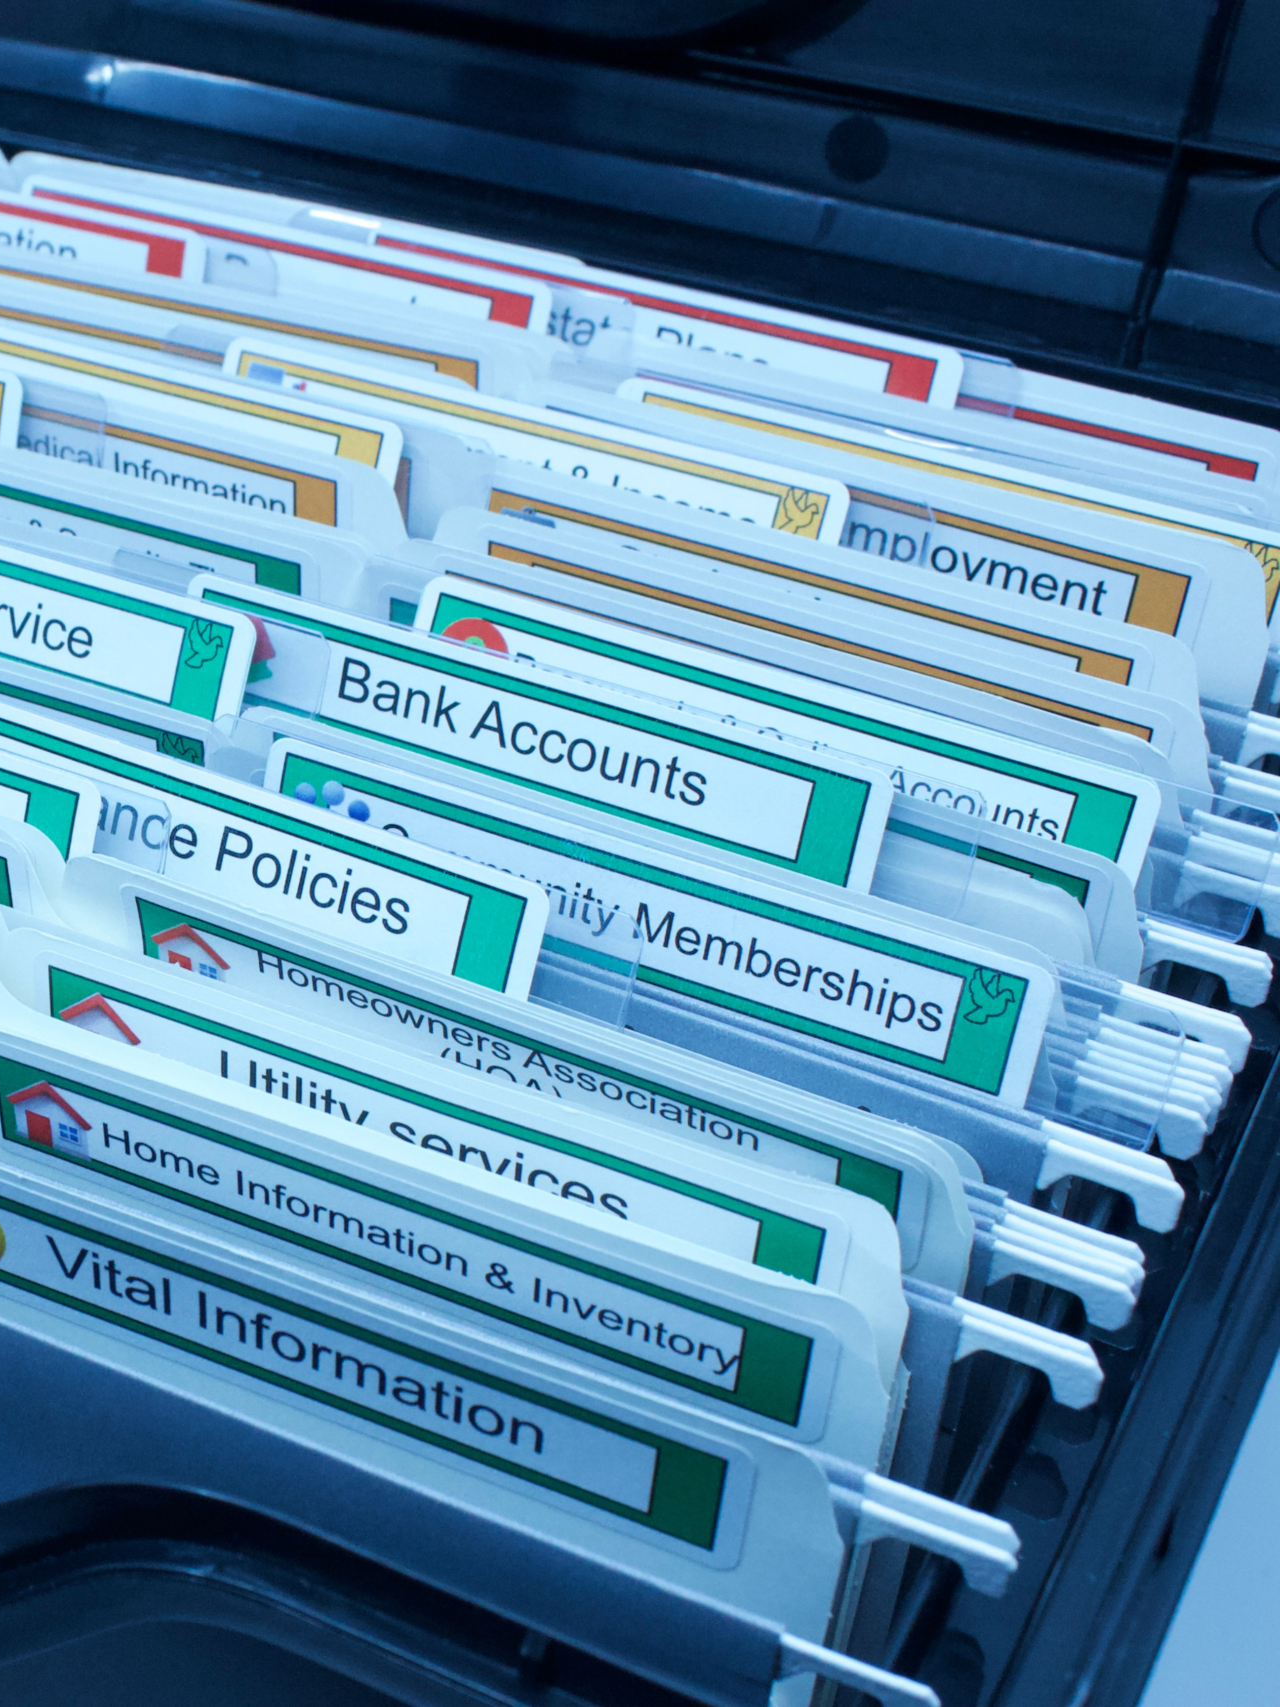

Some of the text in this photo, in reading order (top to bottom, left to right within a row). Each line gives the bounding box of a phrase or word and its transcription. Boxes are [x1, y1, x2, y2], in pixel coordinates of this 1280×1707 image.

[19, 433, 287, 515] edical Information
[337, 656, 461, 734] Bank
[469, 699, 708, 807] Accounts
[214, 825, 411, 936] Policies
[632, 902, 944, 1033] Memberships
[256, 949, 512, 1062] Homeowners
[522, 1049, 760, 1152] Association
[101, 1122, 744, 1376] Home Information & Inventory
[45, 1233, 547, 1456] Vital Information
